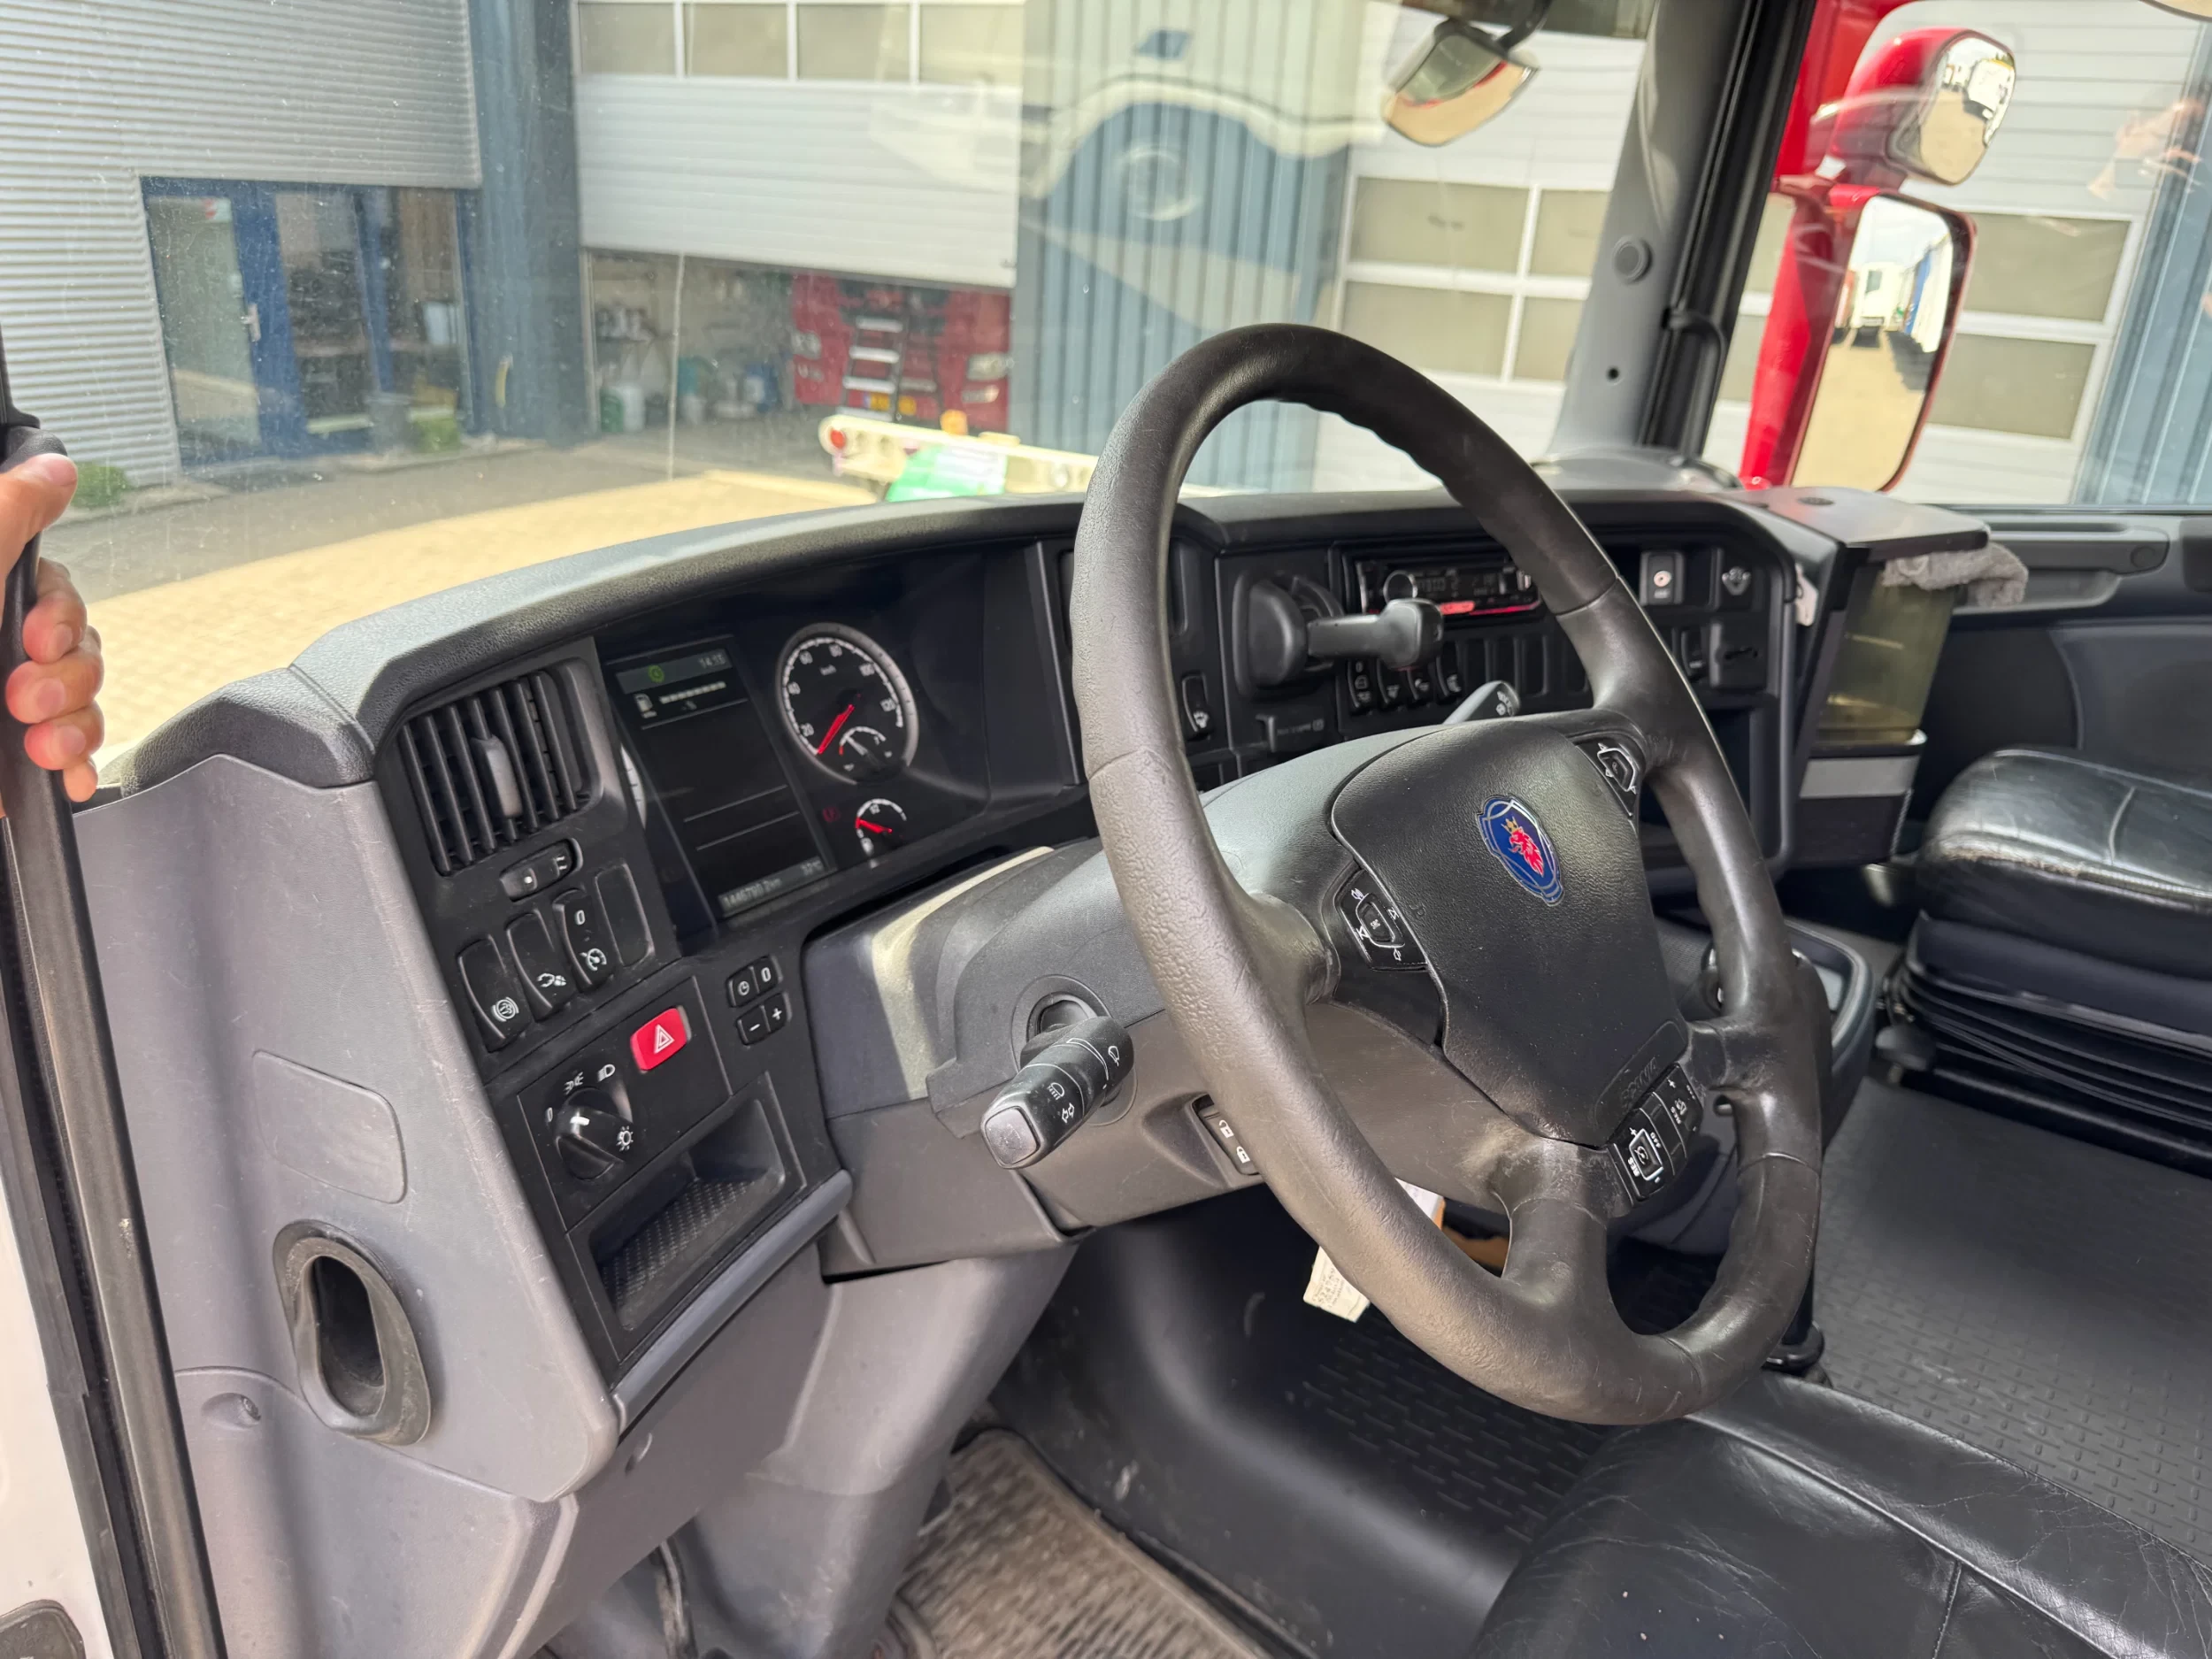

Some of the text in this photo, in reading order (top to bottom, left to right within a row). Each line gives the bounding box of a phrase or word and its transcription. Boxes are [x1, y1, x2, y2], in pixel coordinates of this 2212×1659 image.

[859, 664, 875, 676] 100
[787, 682, 801, 695] 40
[879, 697, 896, 711] 120
[801, 723, 814, 737] 20
[1627, 1156, 1640, 1177] RES
